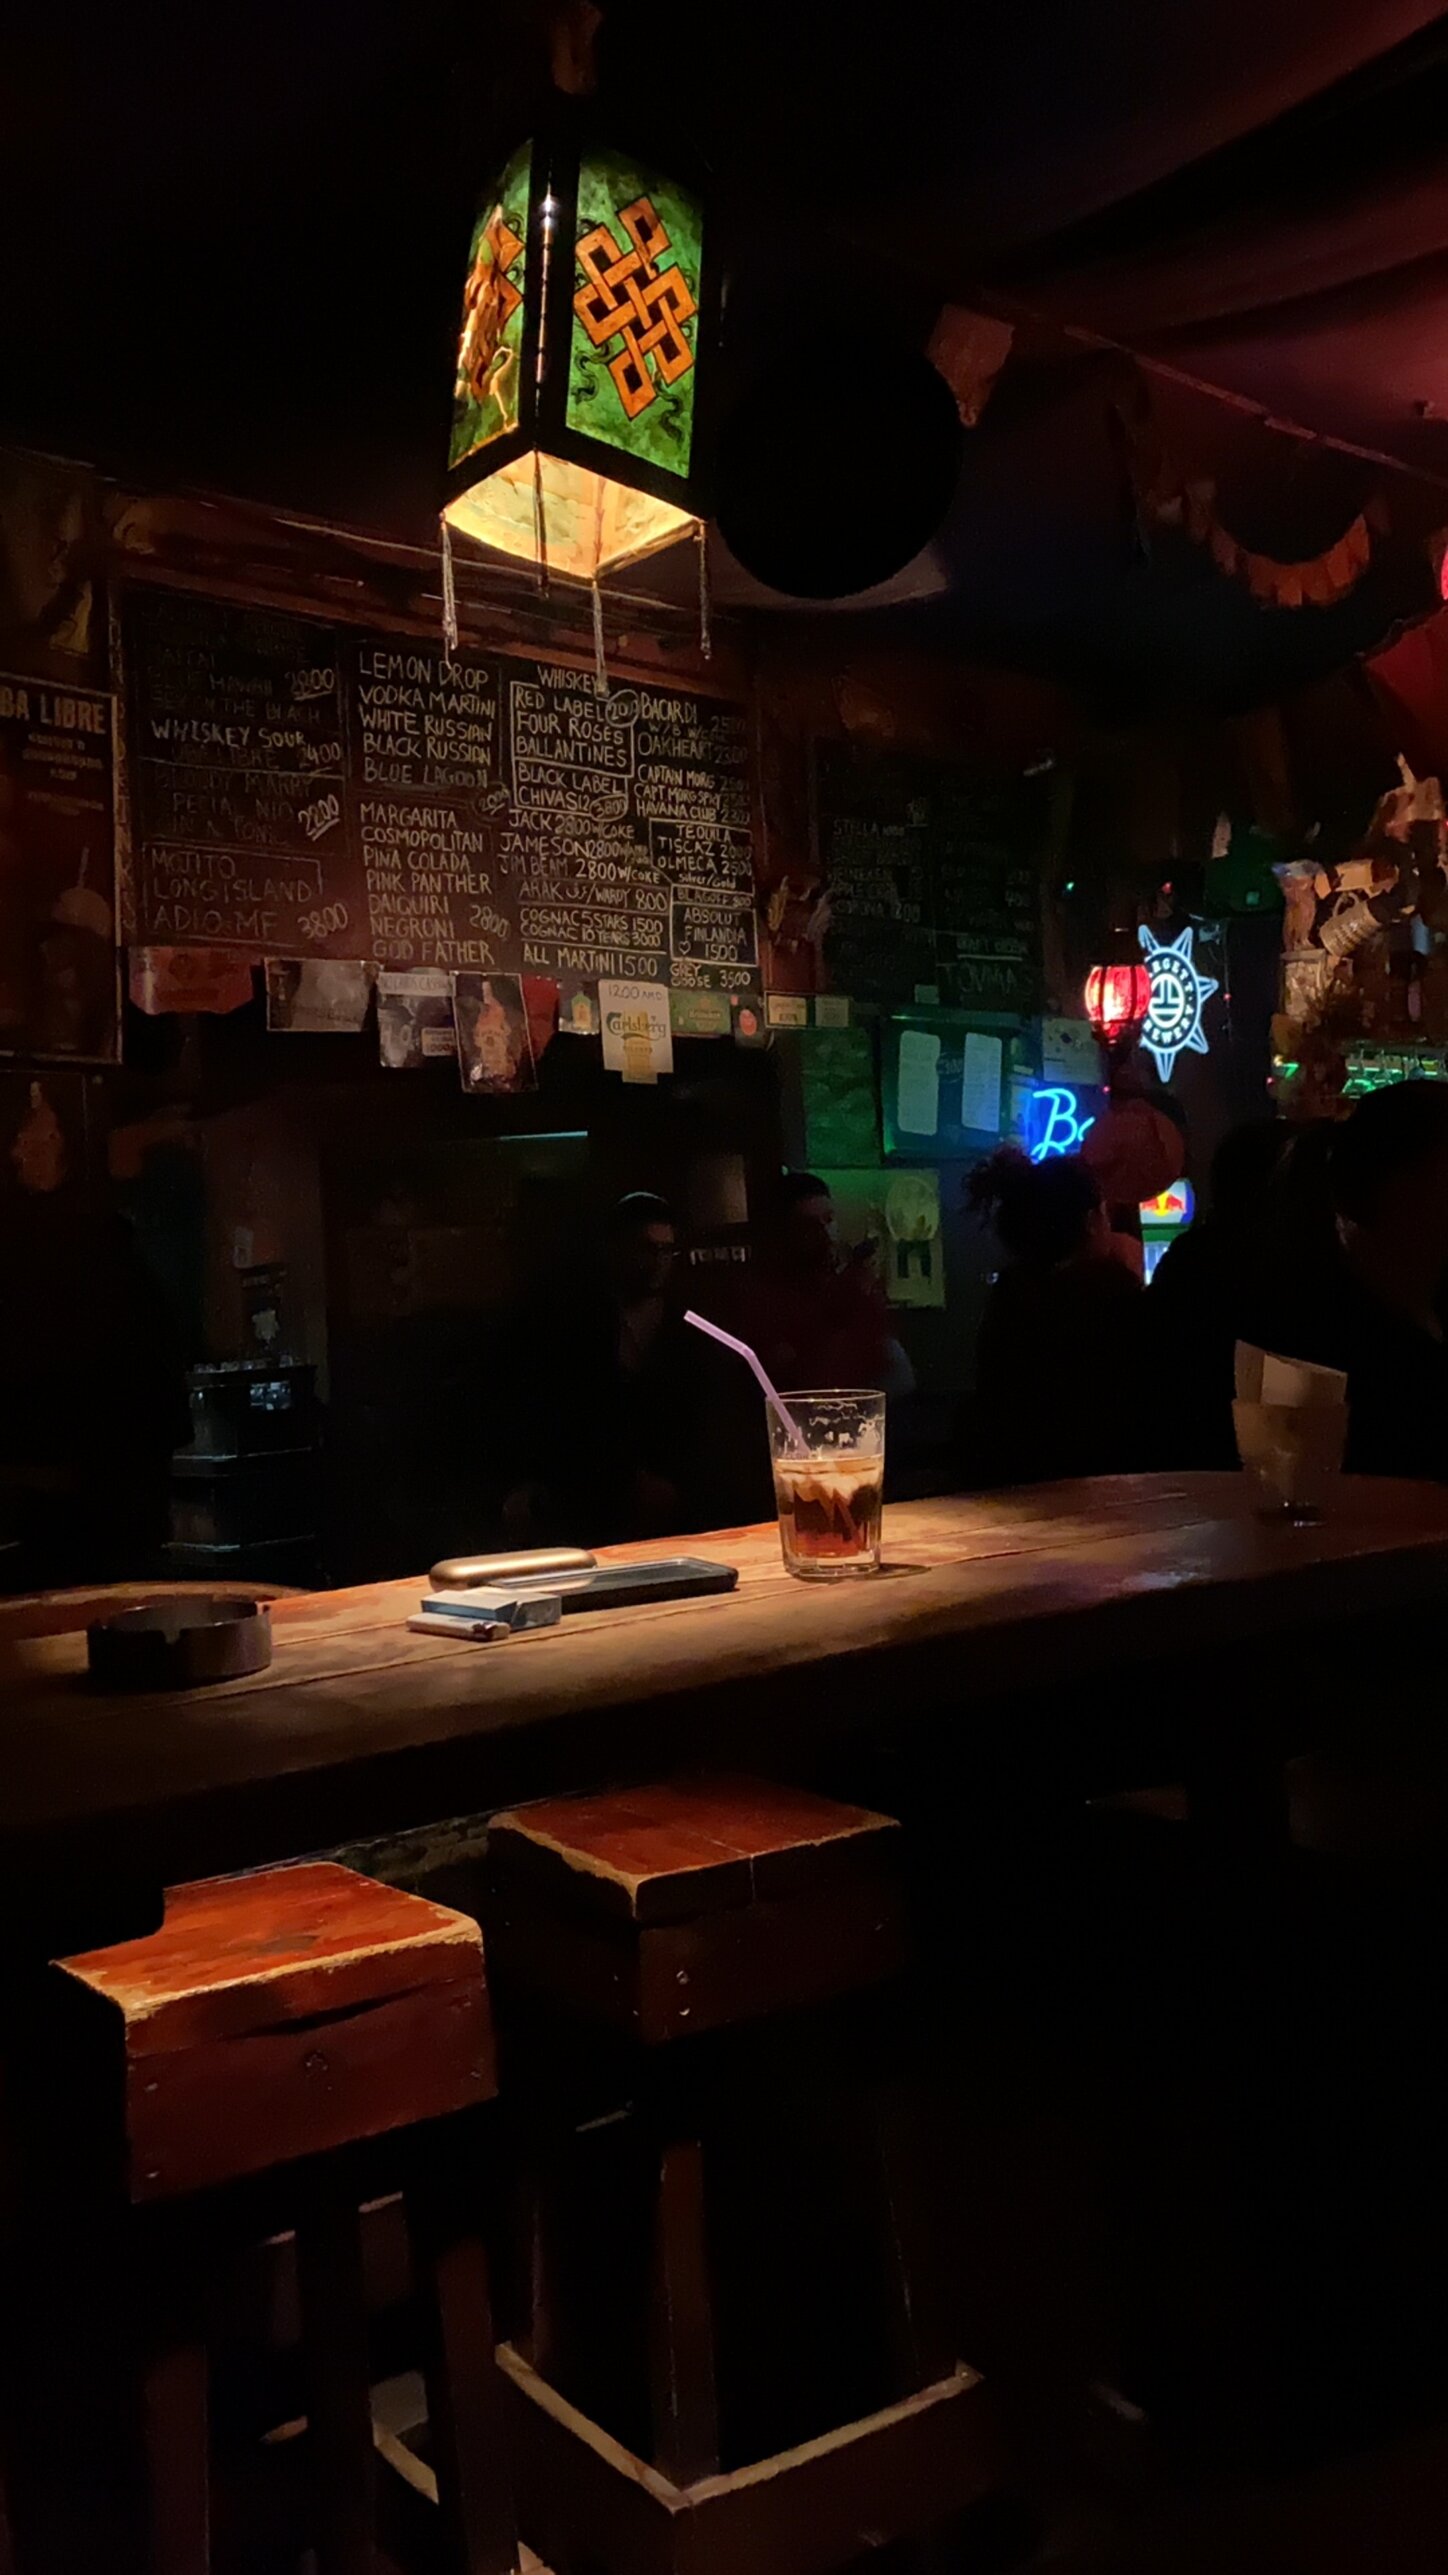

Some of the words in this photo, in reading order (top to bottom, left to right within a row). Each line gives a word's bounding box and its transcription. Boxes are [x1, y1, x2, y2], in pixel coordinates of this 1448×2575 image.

[359, 650, 432, 684] LEMON
[438, 659, 489, 692] DROP
[40, 692, 107, 735] LIBRE
[357, 684, 426, 711] VODKA
[428, 691, 496, 720] MARTINI
[515, 686, 544, 710] RED
[554, 696, 604, 723] LABEL
[641, 692, 697, 724] BACARDI
[151, 718, 250, 747] WHISKEY
[258, 726, 306, 749] SOUR
[357, 702, 421, 735] WHITE
[424, 714, 493, 742] RUSSIAN
[516, 710, 562, 736] FOUR
[568, 717, 624, 745] ROSES
[363, 731, 422, 759] BLACK
[426, 736, 492, 767] RUSSIAN
[516, 735, 627, 768] BALLANTINES
[638, 731, 713, 760] OAKHEART
[364, 756, 413, 784] BLUE
[423, 764, 488, 789] LAGOON
[518, 762, 568, 789] BLACK
[572, 772, 623, 795] LABEL
[518, 785, 577, 812] CHIVAS
[578, 795, 591, 814] 12
[633, 783, 665, 801] CAPT
[360, 801, 459, 829] MARGARITA
[508, 809, 553, 832] JACK
[554, 814, 591, 836] 2800
[636, 799, 688, 818] HAVANA
[689, 804, 717, 822] CLUB
[361, 826, 483, 853] COSMOPOLITAN
[500, 832, 588, 858] JAMESON
[587, 839, 621, 860] 2800
[657, 835, 716, 857] TISCAZ
[675, 824, 733, 844] TEQUILA
[151, 848, 236, 880] MOJITO
[363, 845, 402, 869] PINA
[407, 851, 472, 874] COLADA
[497, 854, 527, 875] JIM
[530, 855, 569, 879] BEAM
[575, 858, 617, 882] 2800
[657, 855, 718, 874] OLMECA
[154, 877, 219, 901] LONG
[222, 879, 312, 904] ISLAND
[366, 869, 406, 893] PINK
[411, 871, 493, 895] PANTHER
[519, 881, 564, 903] ARAK
[635, 888, 667, 911] 800
[368, 893, 449, 916] DAIQUIRI
[683, 907, 741, 926] ABSOLUT
[296, 902, 349, 940] 3800
[370, 916, 455, 940] NEGRONI
[469, 903, 511, 942] 2800
[520, 907, 580, 927] COGNAC
[581, 910, 594, 928] 5
[632, 916, 663, 935] 1500
[520, 921, 578, 941] COGNAC
[581, 927, 596, 942] 10
[631, 932, 662, 948] 3000
[685, 925, 748, 946] FINLANDIA
[372, 939, 414, 959] GOD
[422, 939, 495, 966] FATHER
[523, 943, 550, 966] ALL
[705, 943, 739, 962] 1500
[670, 962, 702, 977] GREY
[719, 969, 752, 989] 3500
[606, 1011, 667, 1038] Carlsberg
